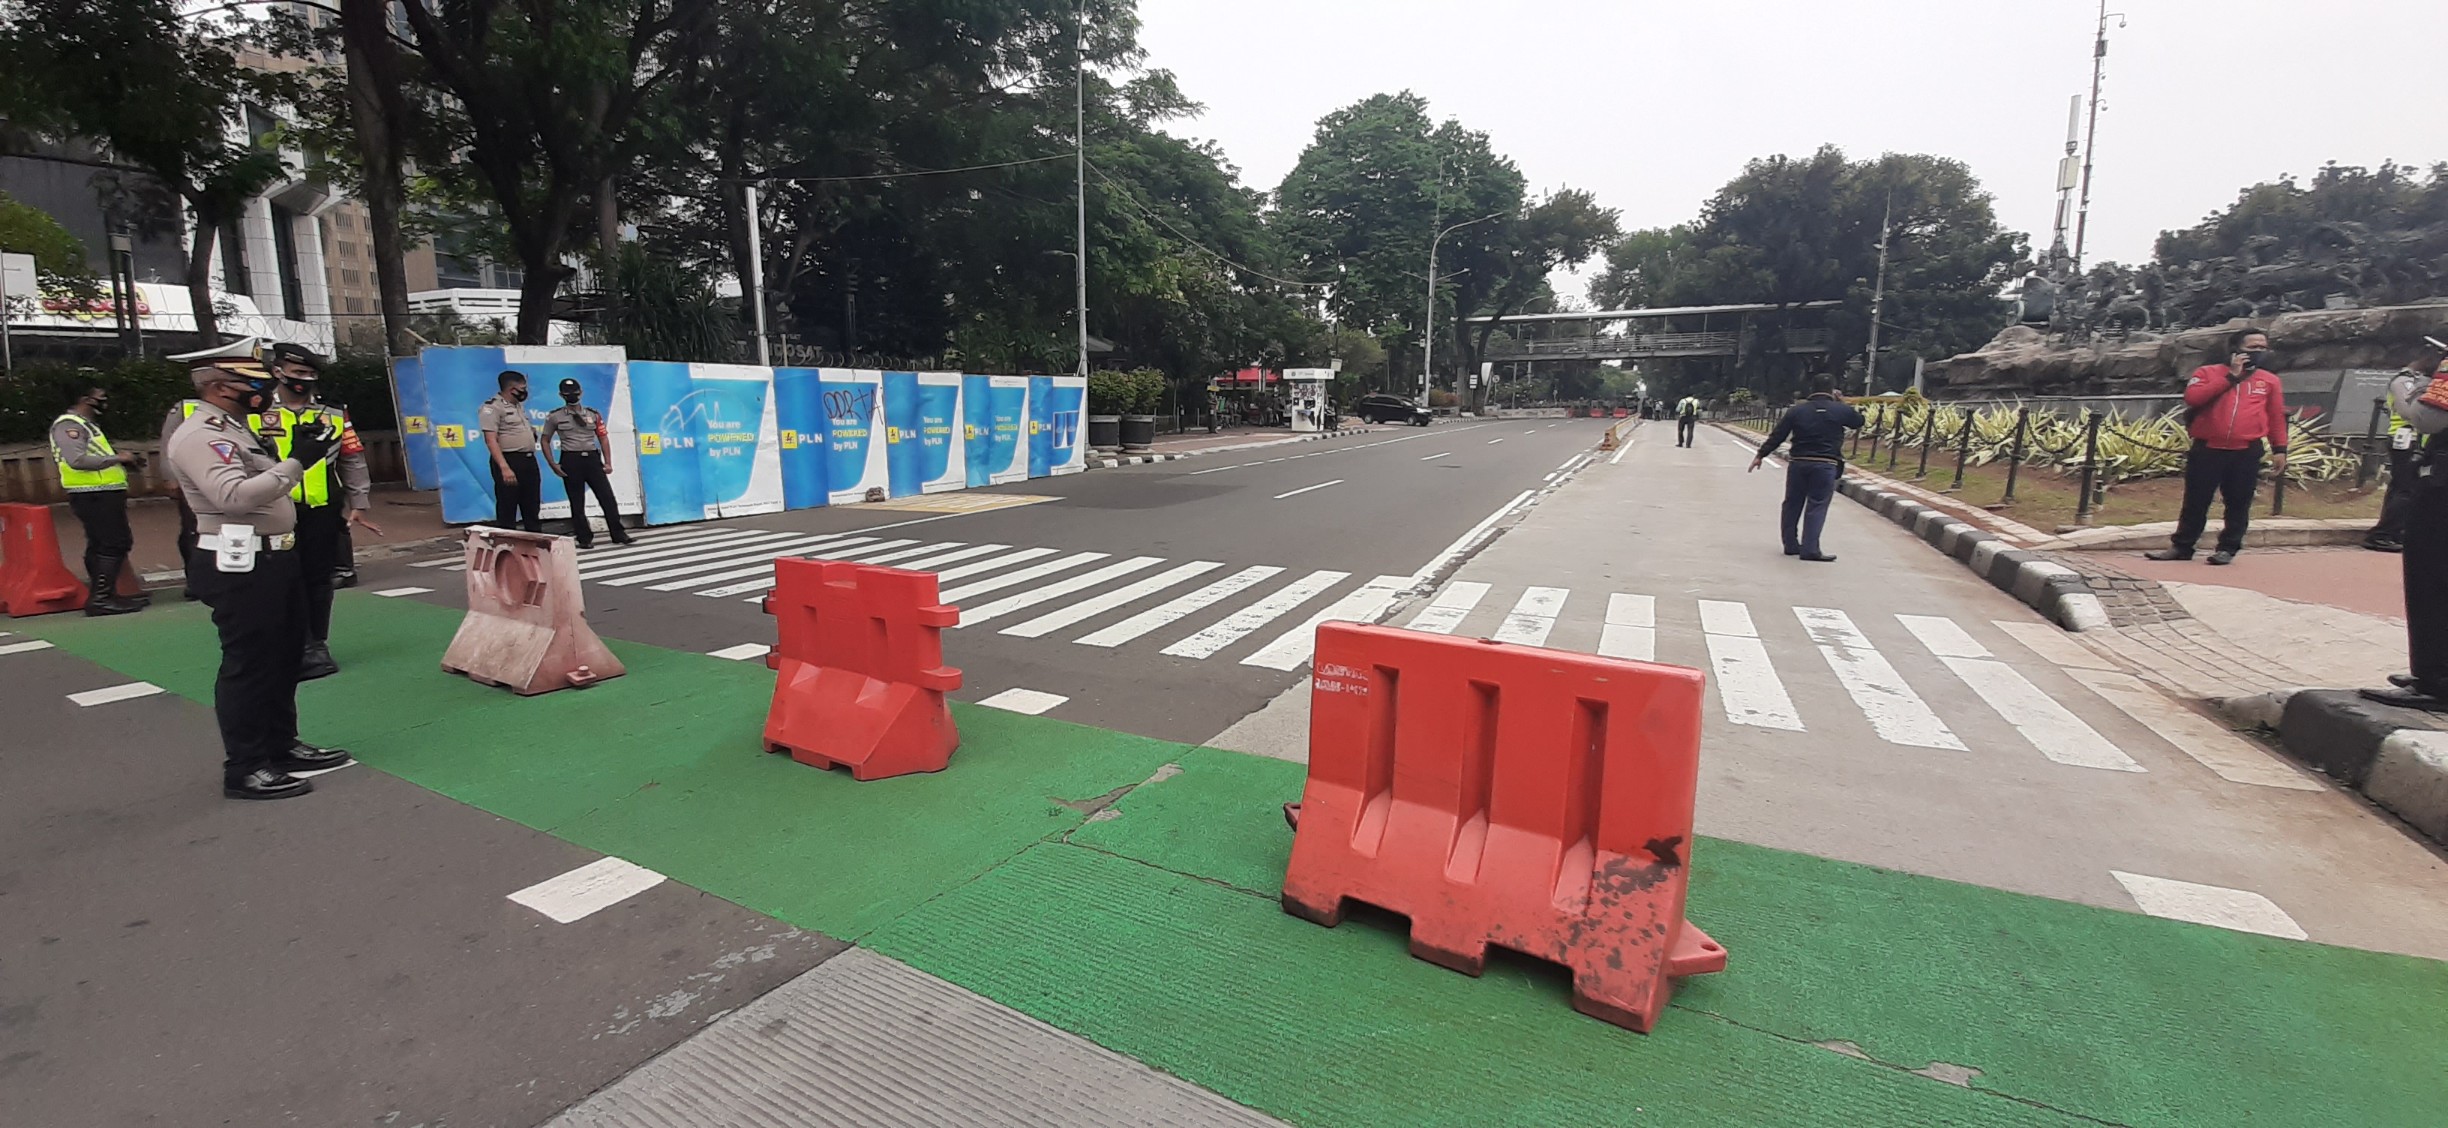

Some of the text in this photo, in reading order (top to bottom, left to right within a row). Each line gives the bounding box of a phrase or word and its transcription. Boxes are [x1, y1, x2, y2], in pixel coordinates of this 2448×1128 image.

[726, 421, 741, 429] are
[1038, 423, 1052, 431] PLN
[899, 429, 917, 439] PLN
[974, 427, 990, 436] PLN
[662, 436, 694, 449] PLN
[798, 433, 823, 444] PLN
[833, 441, 858, 451] by PLN
[709, 447, 741, 458] by PLN
